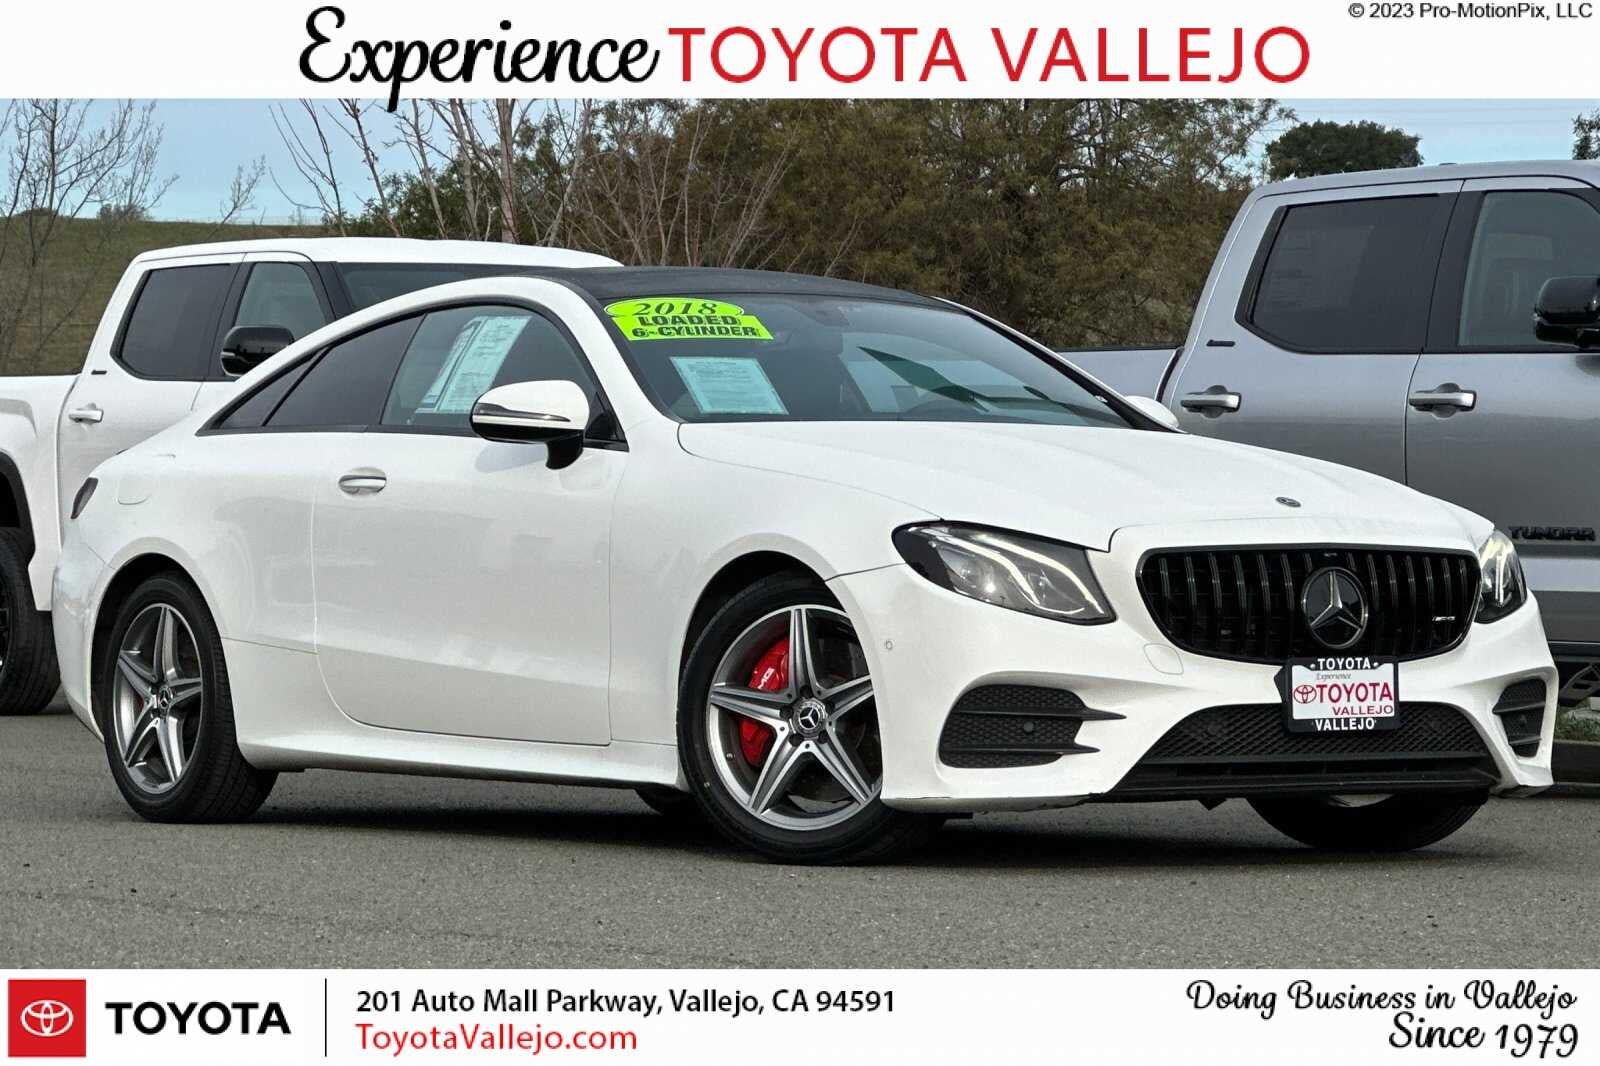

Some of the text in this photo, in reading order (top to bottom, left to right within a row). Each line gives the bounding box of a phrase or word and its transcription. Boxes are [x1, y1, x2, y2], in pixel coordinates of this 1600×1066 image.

[633, 302, 717, 315] 2018
[638, 315, 741, 326] LOADED
[632, 326, 760, 337] 6-CYLINDER
[1318, 658, 1371, 670] TOYOTA
[1316, 682, 1393, 703] TOYOTA
[1333, 705, 1393, 716] VALLEJO
[1315, 718, 1375, 731] VALLEJO
